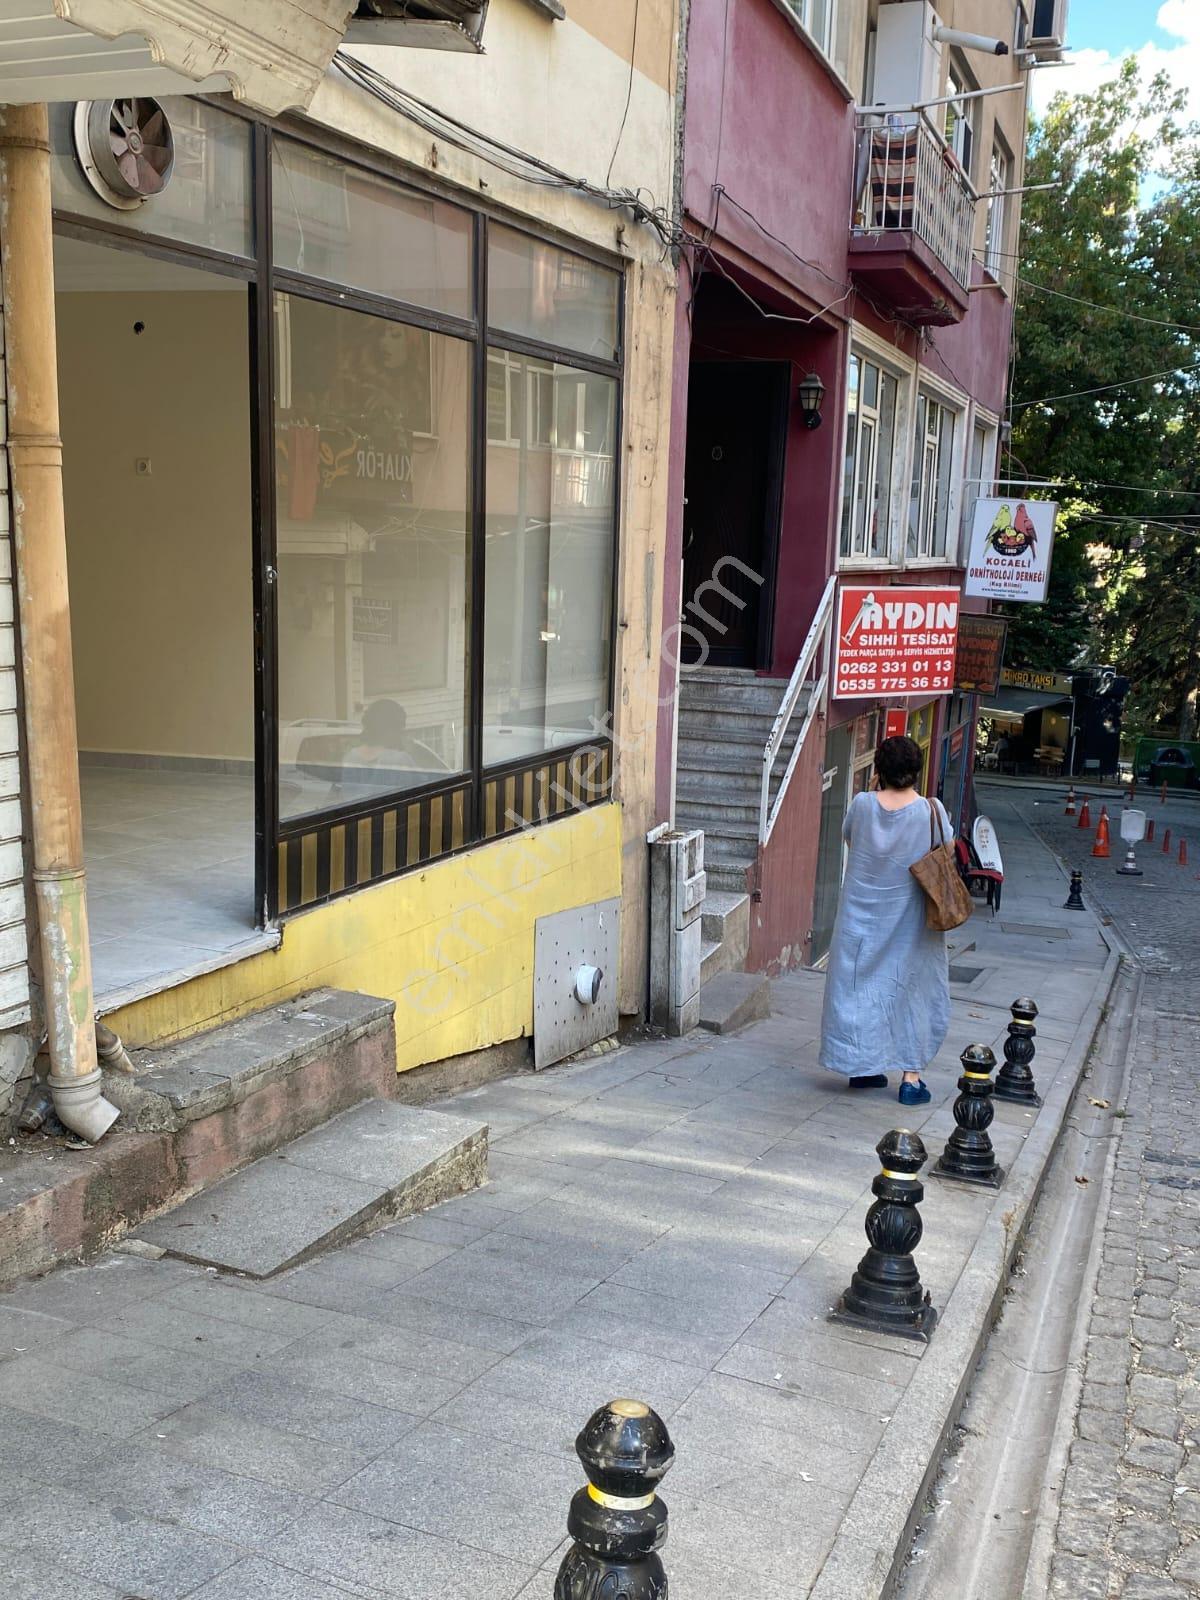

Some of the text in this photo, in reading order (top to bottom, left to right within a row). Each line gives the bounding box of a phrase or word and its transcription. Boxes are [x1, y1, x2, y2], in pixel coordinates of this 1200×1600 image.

[986, 557, 1031, 568] KOCAELİ
[861, 602, 958, 630] AYDIN
[859, 631, 897, 646] SIHHİ
[902, 630, 955, 645] TESİSAT
[840, 649, 858, 657] YEDEK
[859, 648, 877, 658] PARÇA
[840, 660, 952, 674] 0262 331 01 13
[839, 676, 949, 691] 0535 775 36 51
